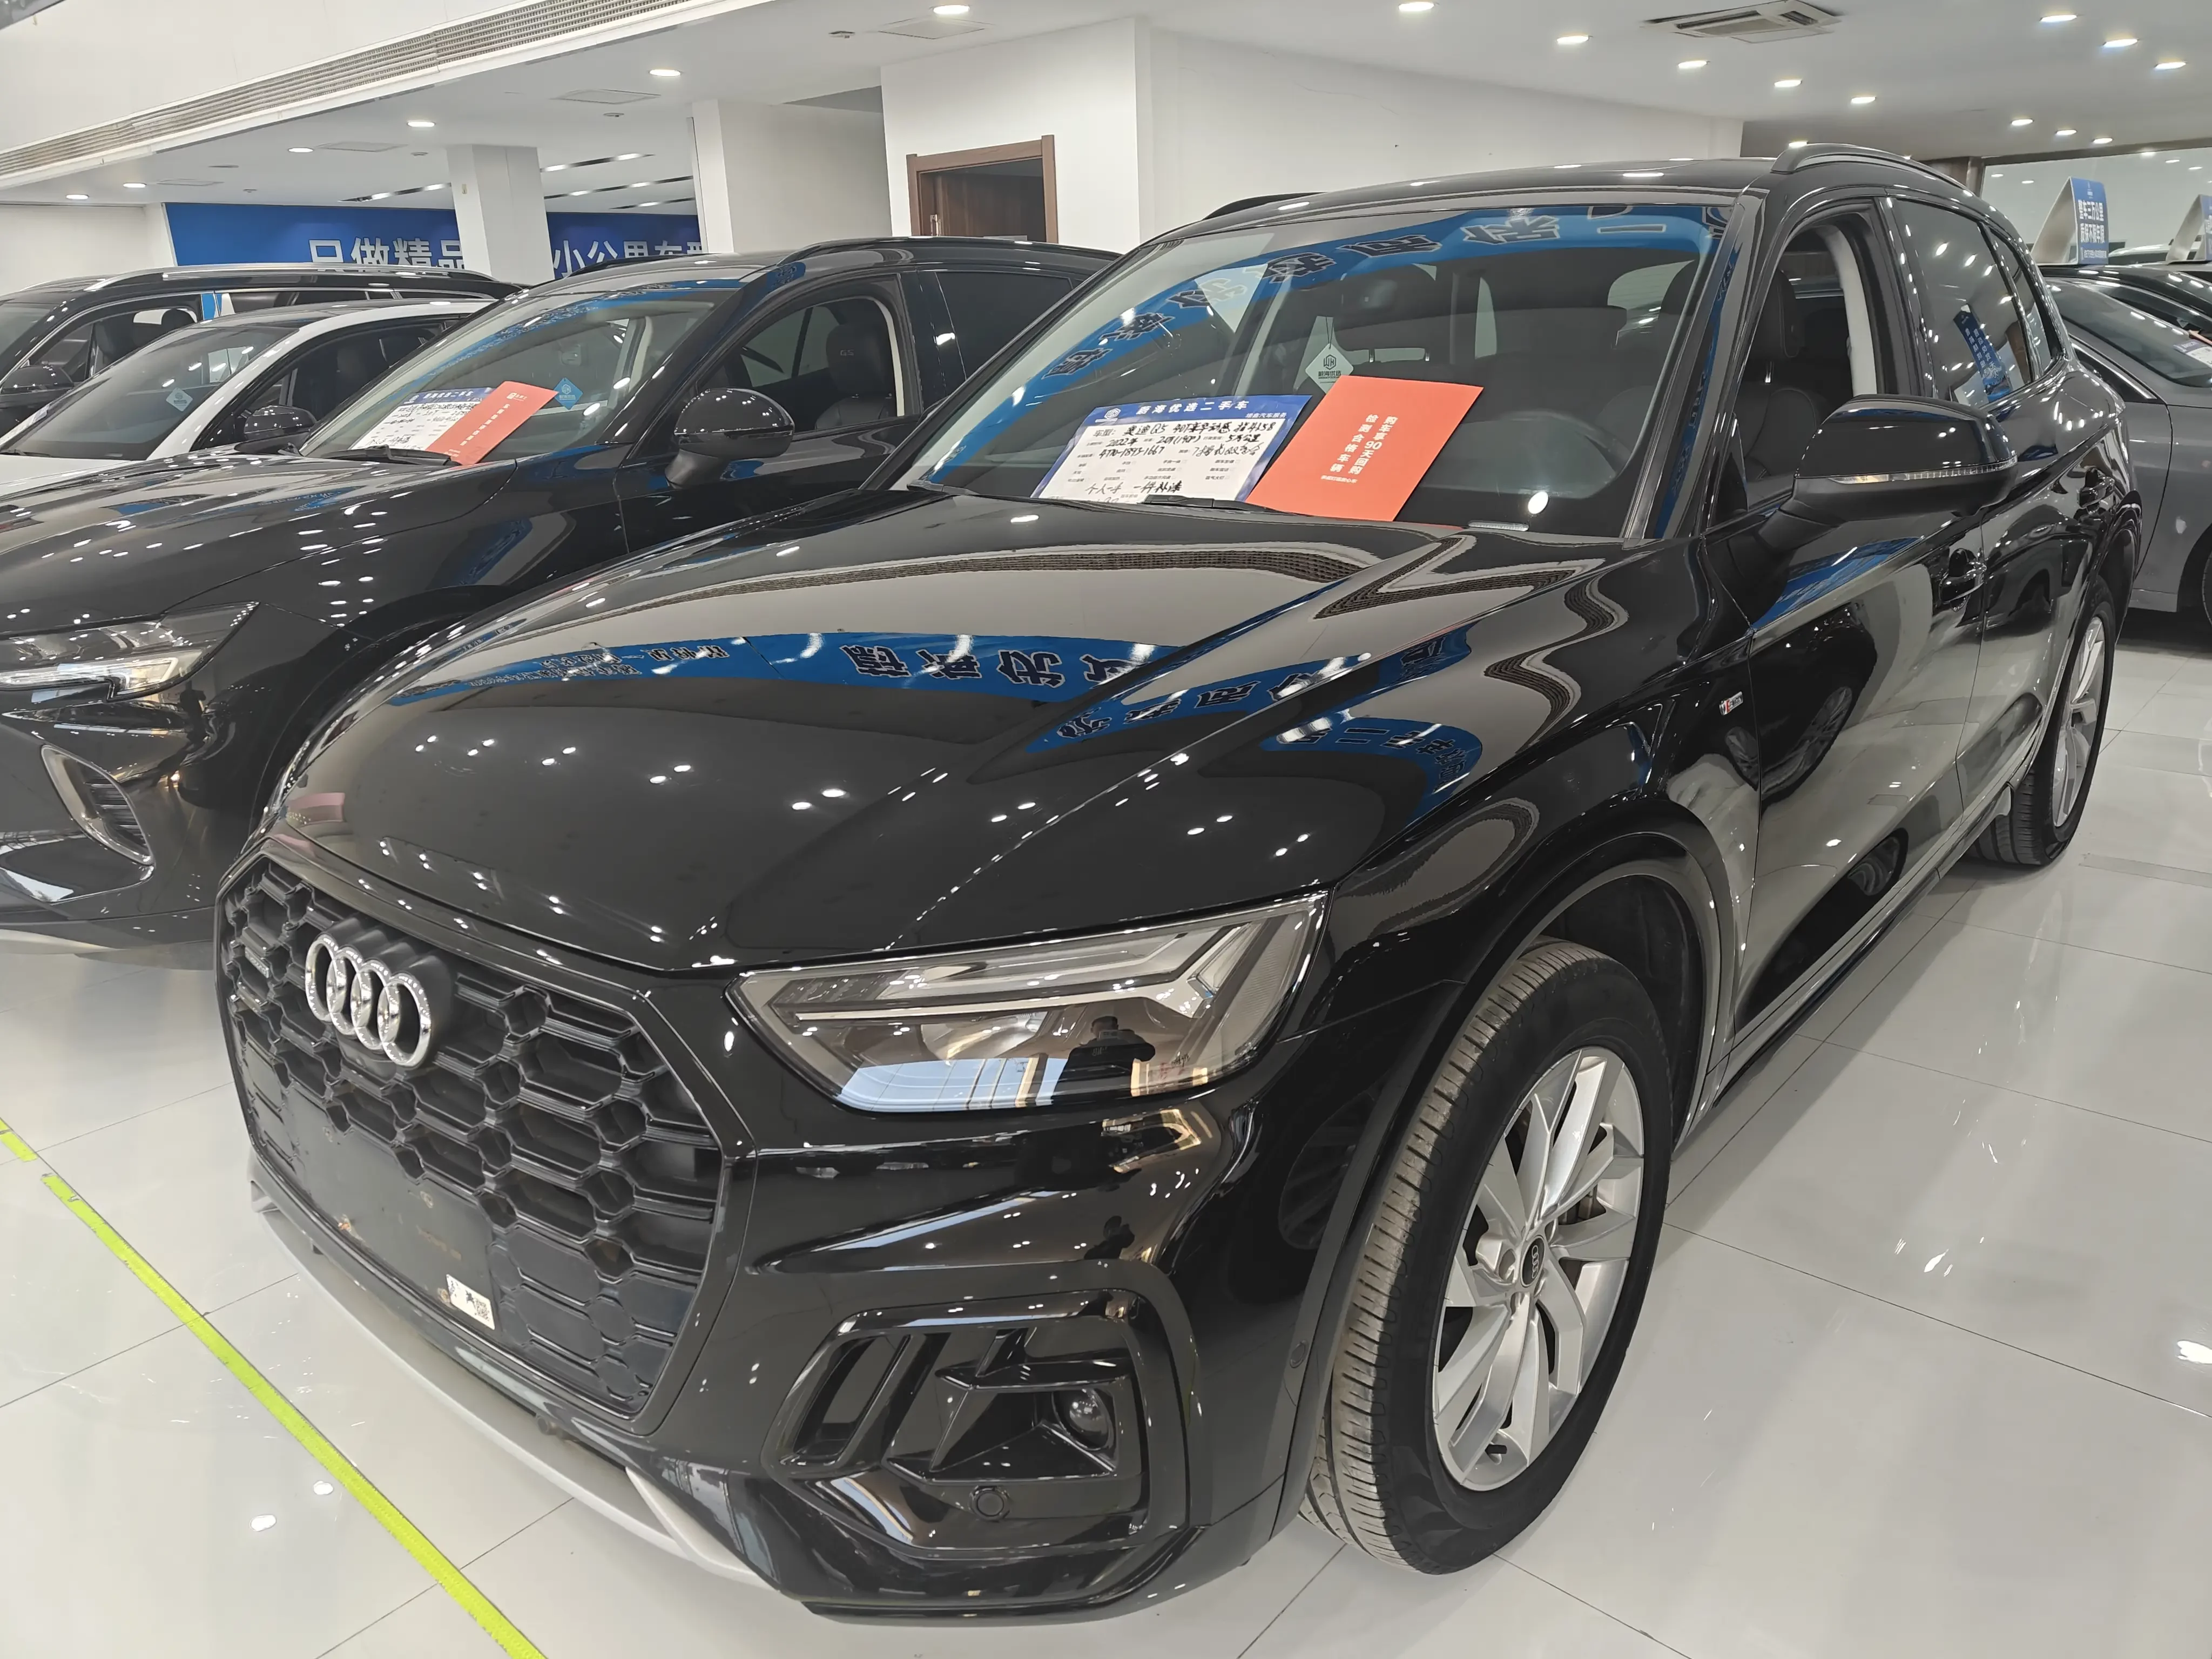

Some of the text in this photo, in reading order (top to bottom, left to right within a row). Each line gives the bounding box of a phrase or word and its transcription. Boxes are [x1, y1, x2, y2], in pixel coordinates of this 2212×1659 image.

[1330, 414, 1379, 473] 检测合格车辆
